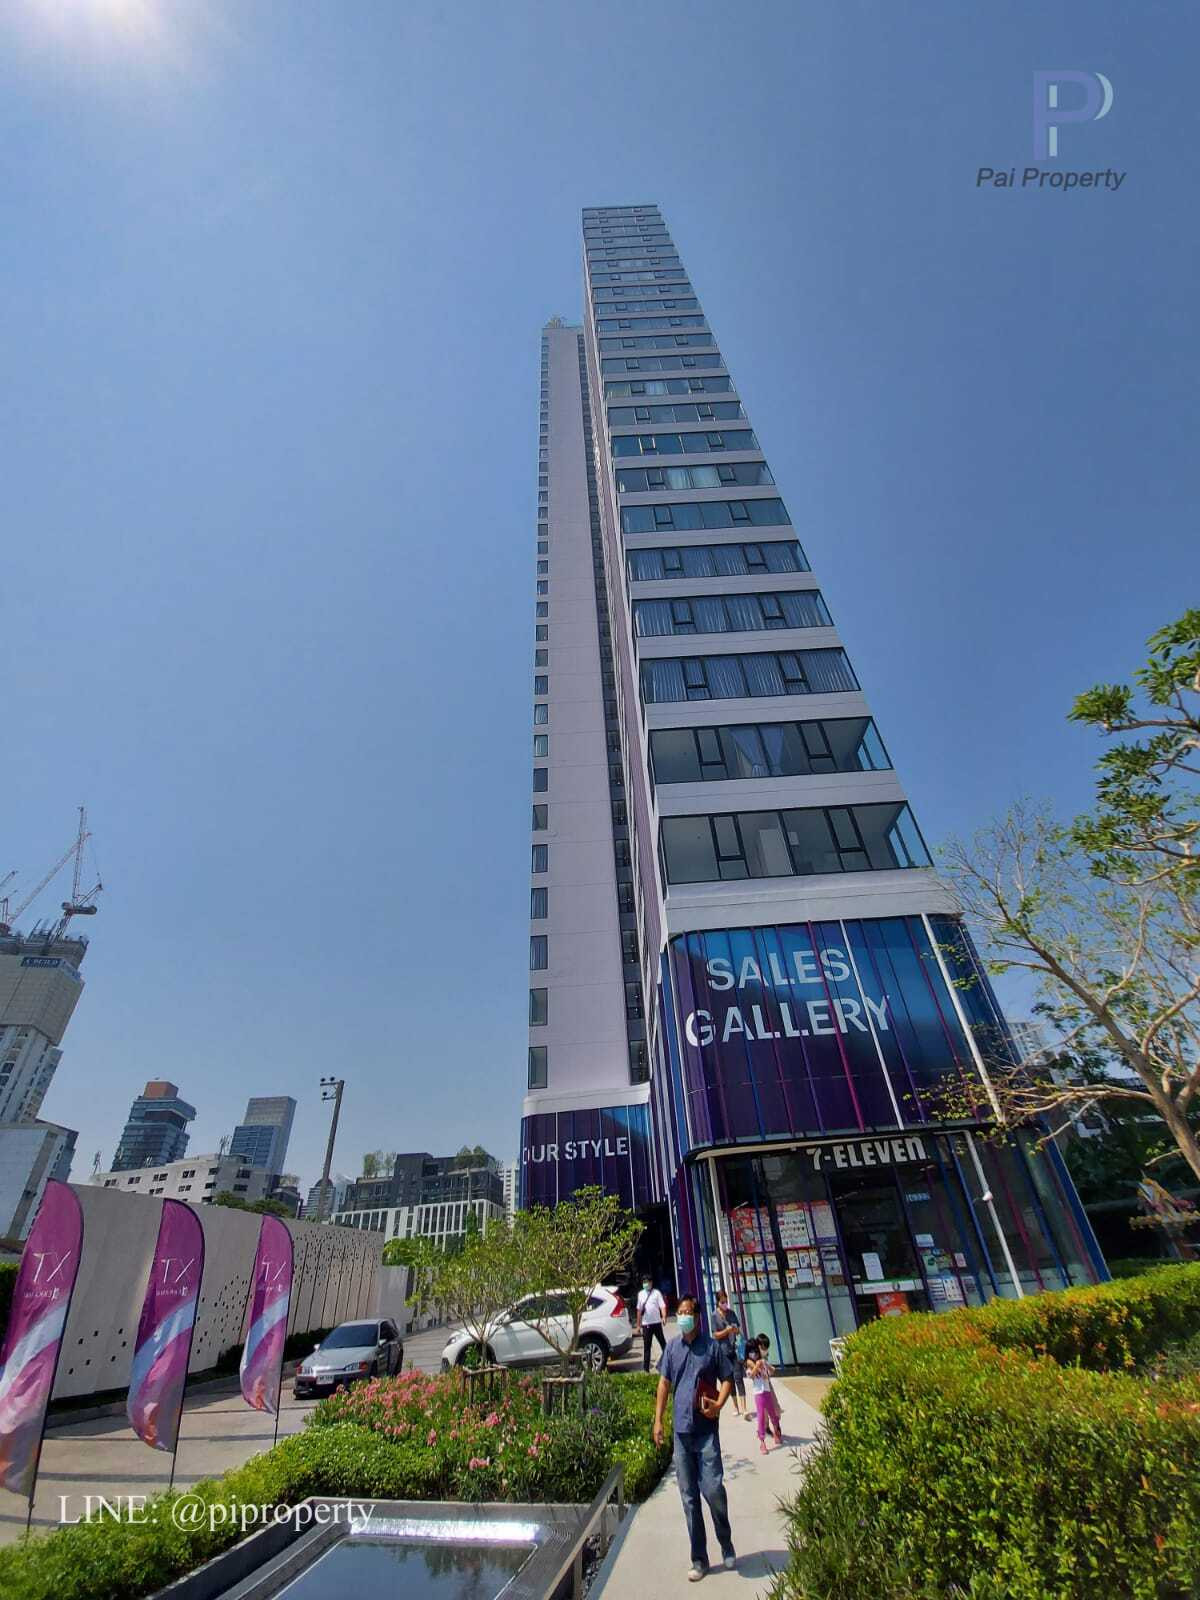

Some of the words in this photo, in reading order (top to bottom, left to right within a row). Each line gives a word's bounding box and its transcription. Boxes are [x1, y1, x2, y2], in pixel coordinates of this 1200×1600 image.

[706, 948, 850, 991] SALES
[685, 995, 890, 1047] GALLERY
[564, 1137, 629, 1160] STYLE
